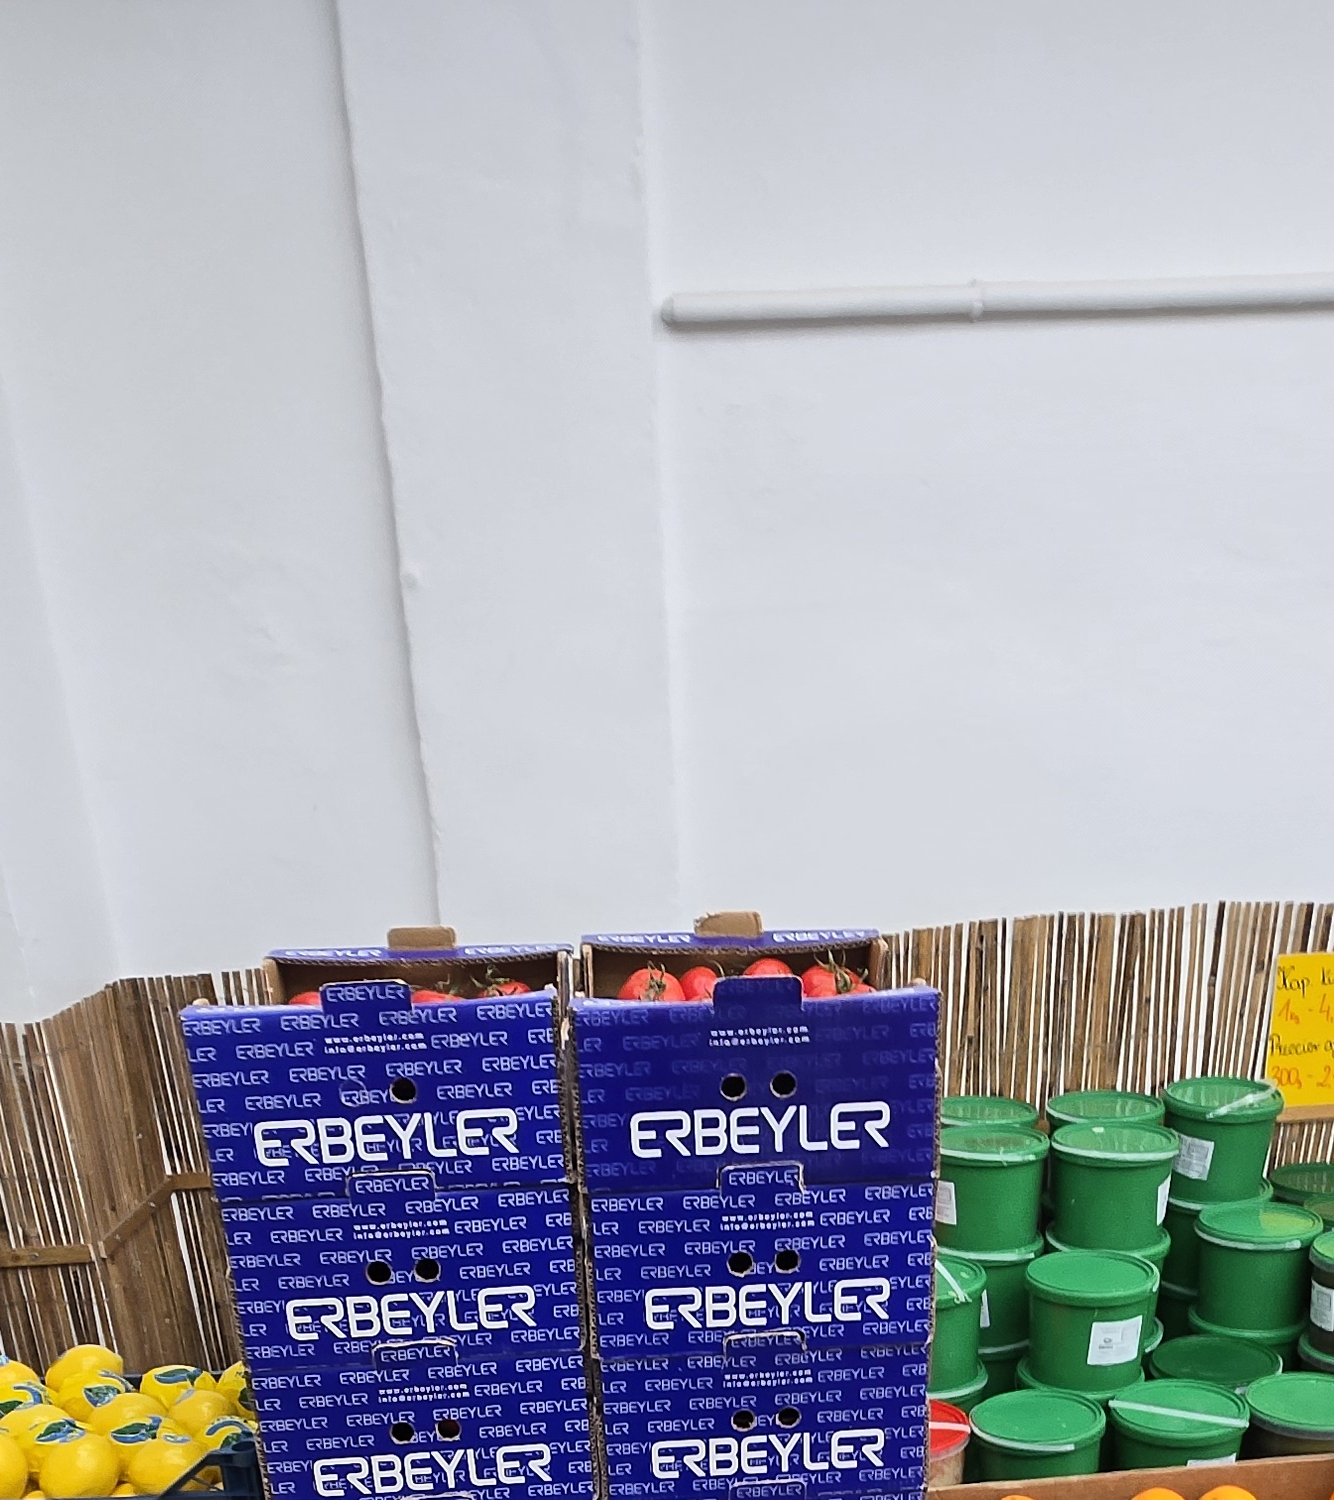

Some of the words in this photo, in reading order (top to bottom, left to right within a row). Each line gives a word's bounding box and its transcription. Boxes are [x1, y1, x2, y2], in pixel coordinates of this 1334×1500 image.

[254, 1109, 519, 1167] ERBEYLER
[629, 1101, 891, 1158] ERBEYLER
[286, 1286, 537, 1340] ERBEYLER
[645, 1277, 891, 1330] ERBEYLER
[314, 1444, 552, 1496] ERBEYLER
[652, 1429, 885, 1479] ERBEYLER
